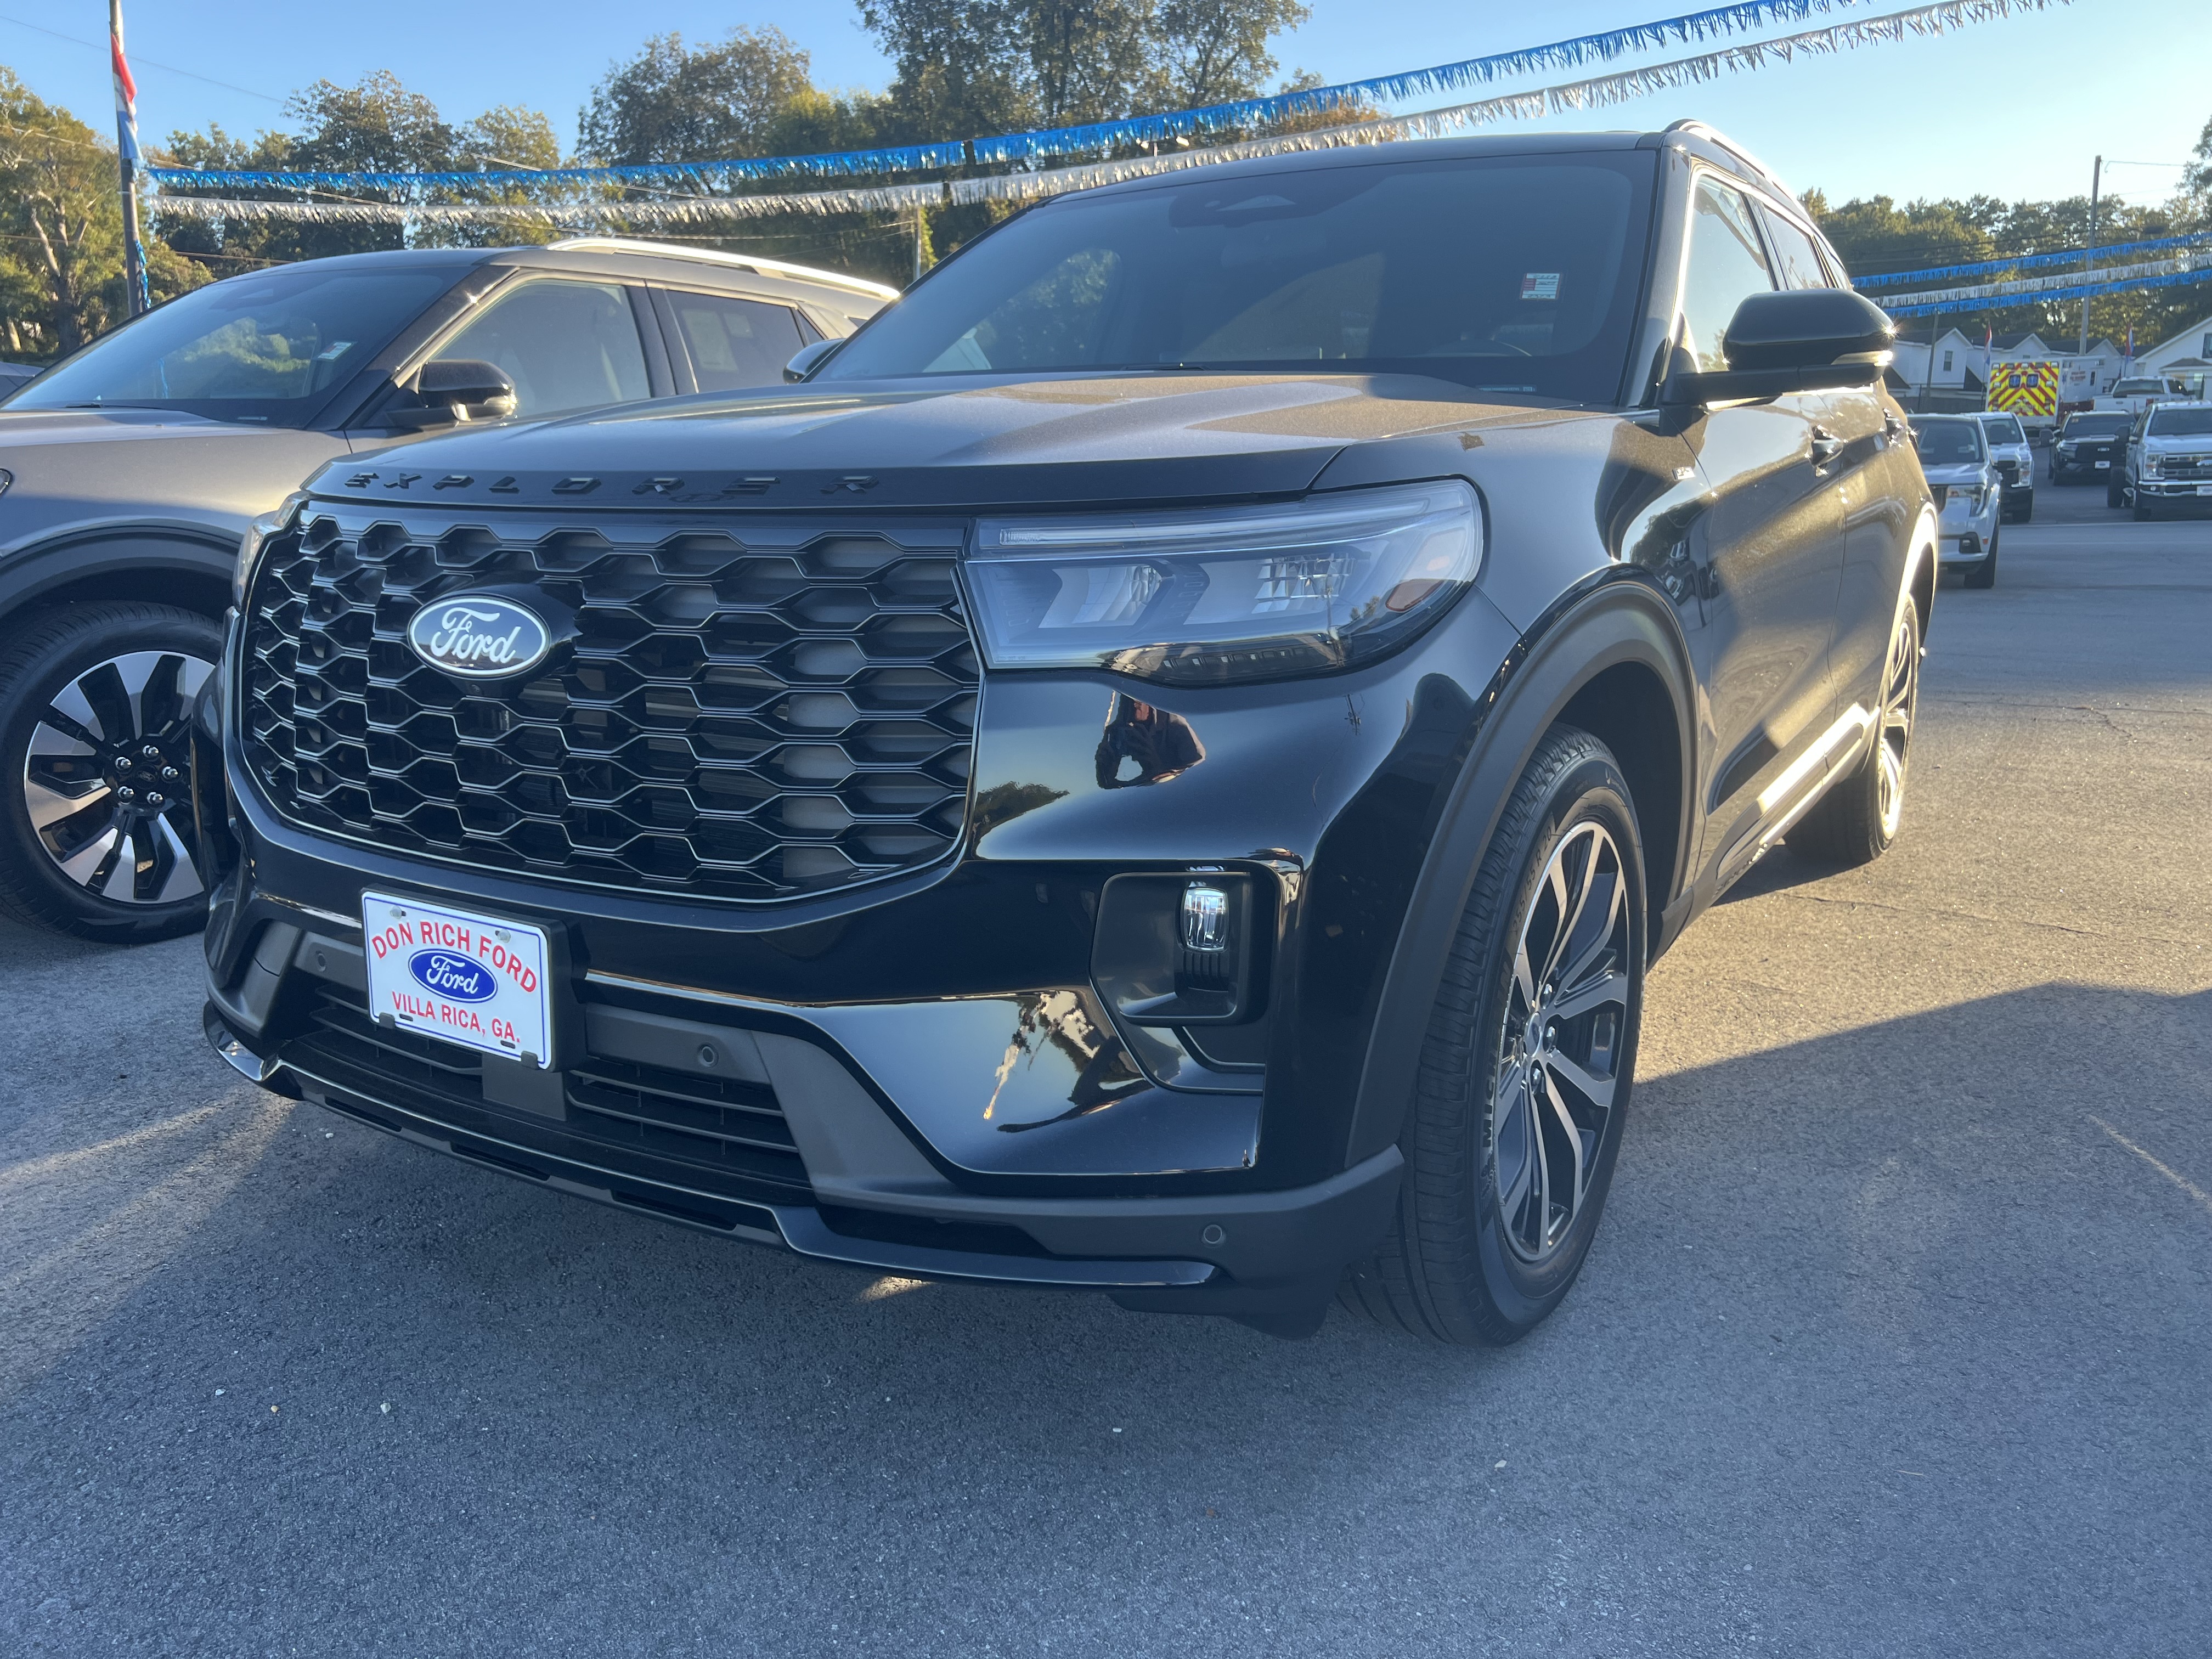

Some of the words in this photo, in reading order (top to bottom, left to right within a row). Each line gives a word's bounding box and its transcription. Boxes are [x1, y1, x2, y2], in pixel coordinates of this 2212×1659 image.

[344, 472, 879, 495] EXPLORER
[430, 607, 521, 664] Ford
[1542, 826, 1552, 851] 20
[371, 922, 414, 960] DON
[420, 921, 470, 952] RICH
[479, 935, 537, 993] FORD
[426, 955, 478, 994] Ford
[392, 991, 436, 1020] VILLA
[441, 1004, 486, 1037] RICA,
[491, 1018, 521, 1043] GA.
